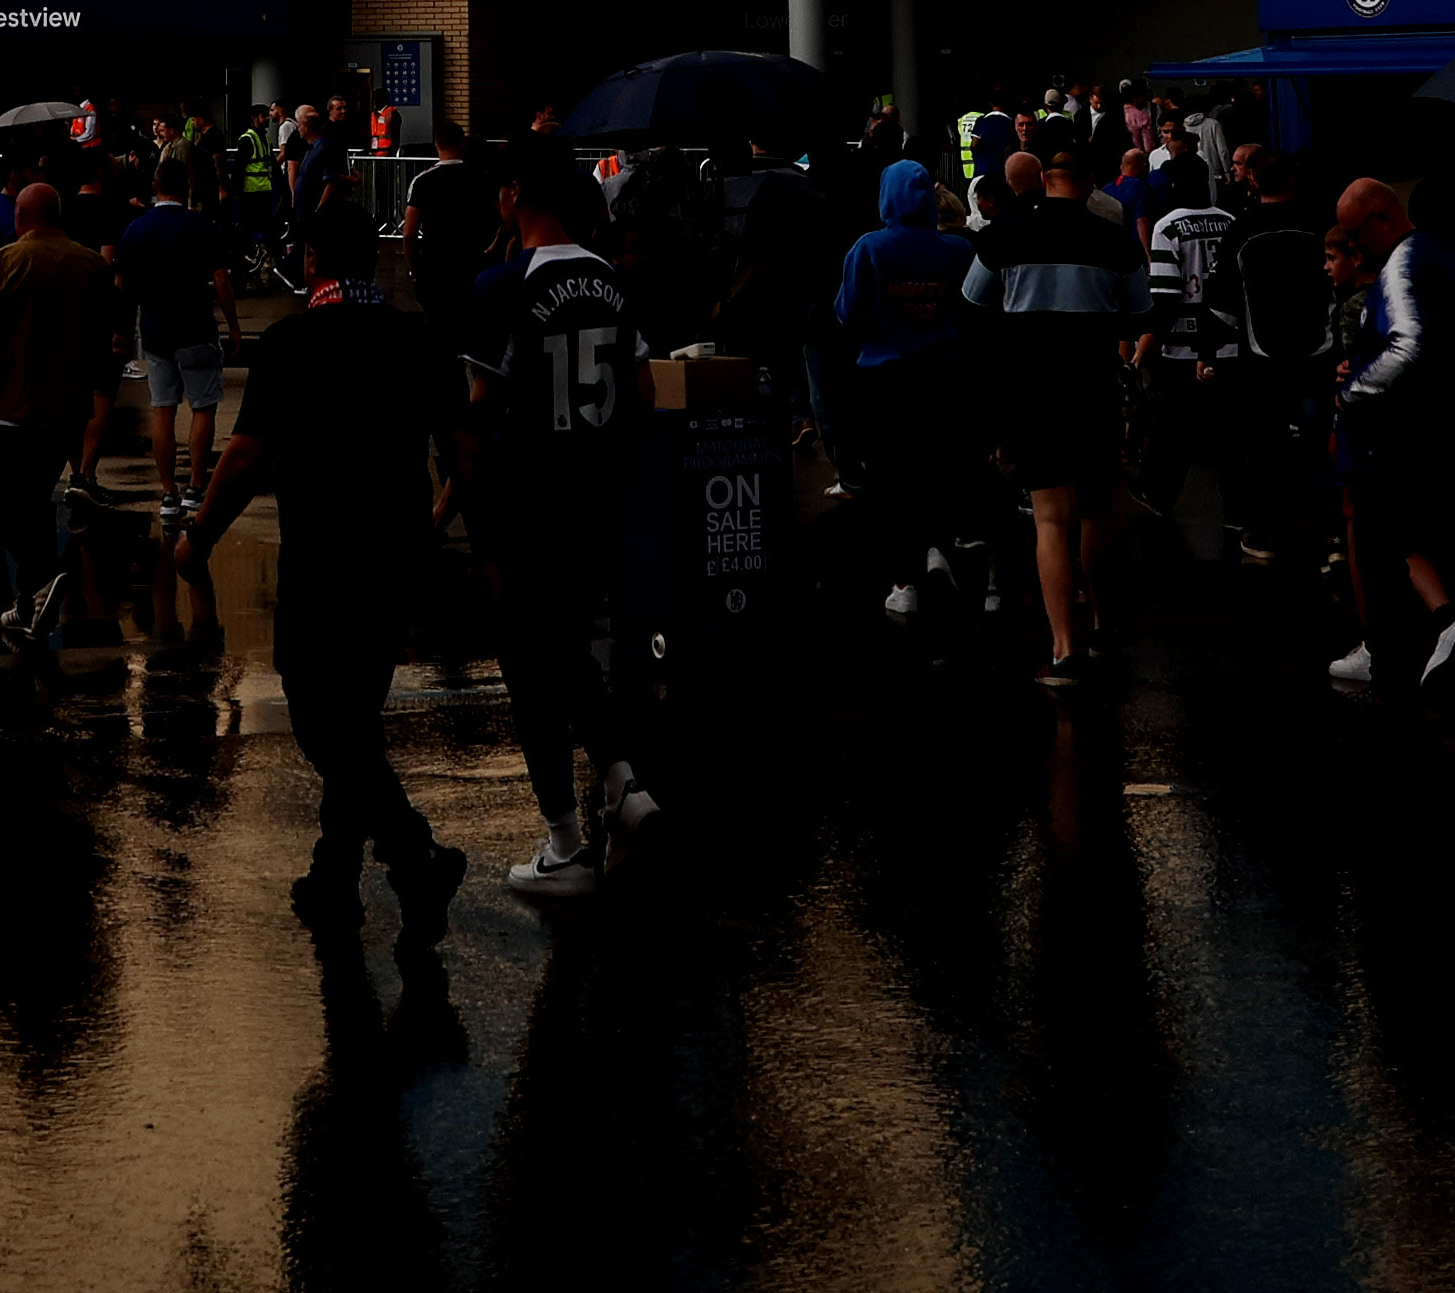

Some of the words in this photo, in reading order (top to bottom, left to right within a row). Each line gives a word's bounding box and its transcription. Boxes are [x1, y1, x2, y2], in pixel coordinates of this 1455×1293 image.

[531, 277, 625, 323] N.JACKSON
[542, 326, 619, 431] 15
[705, 473, 761, 509] ON
[707, 509, 762, 533] SALE
[707, 532, 762, 554] HERE
[722, 555, 762, 572] £4.00
